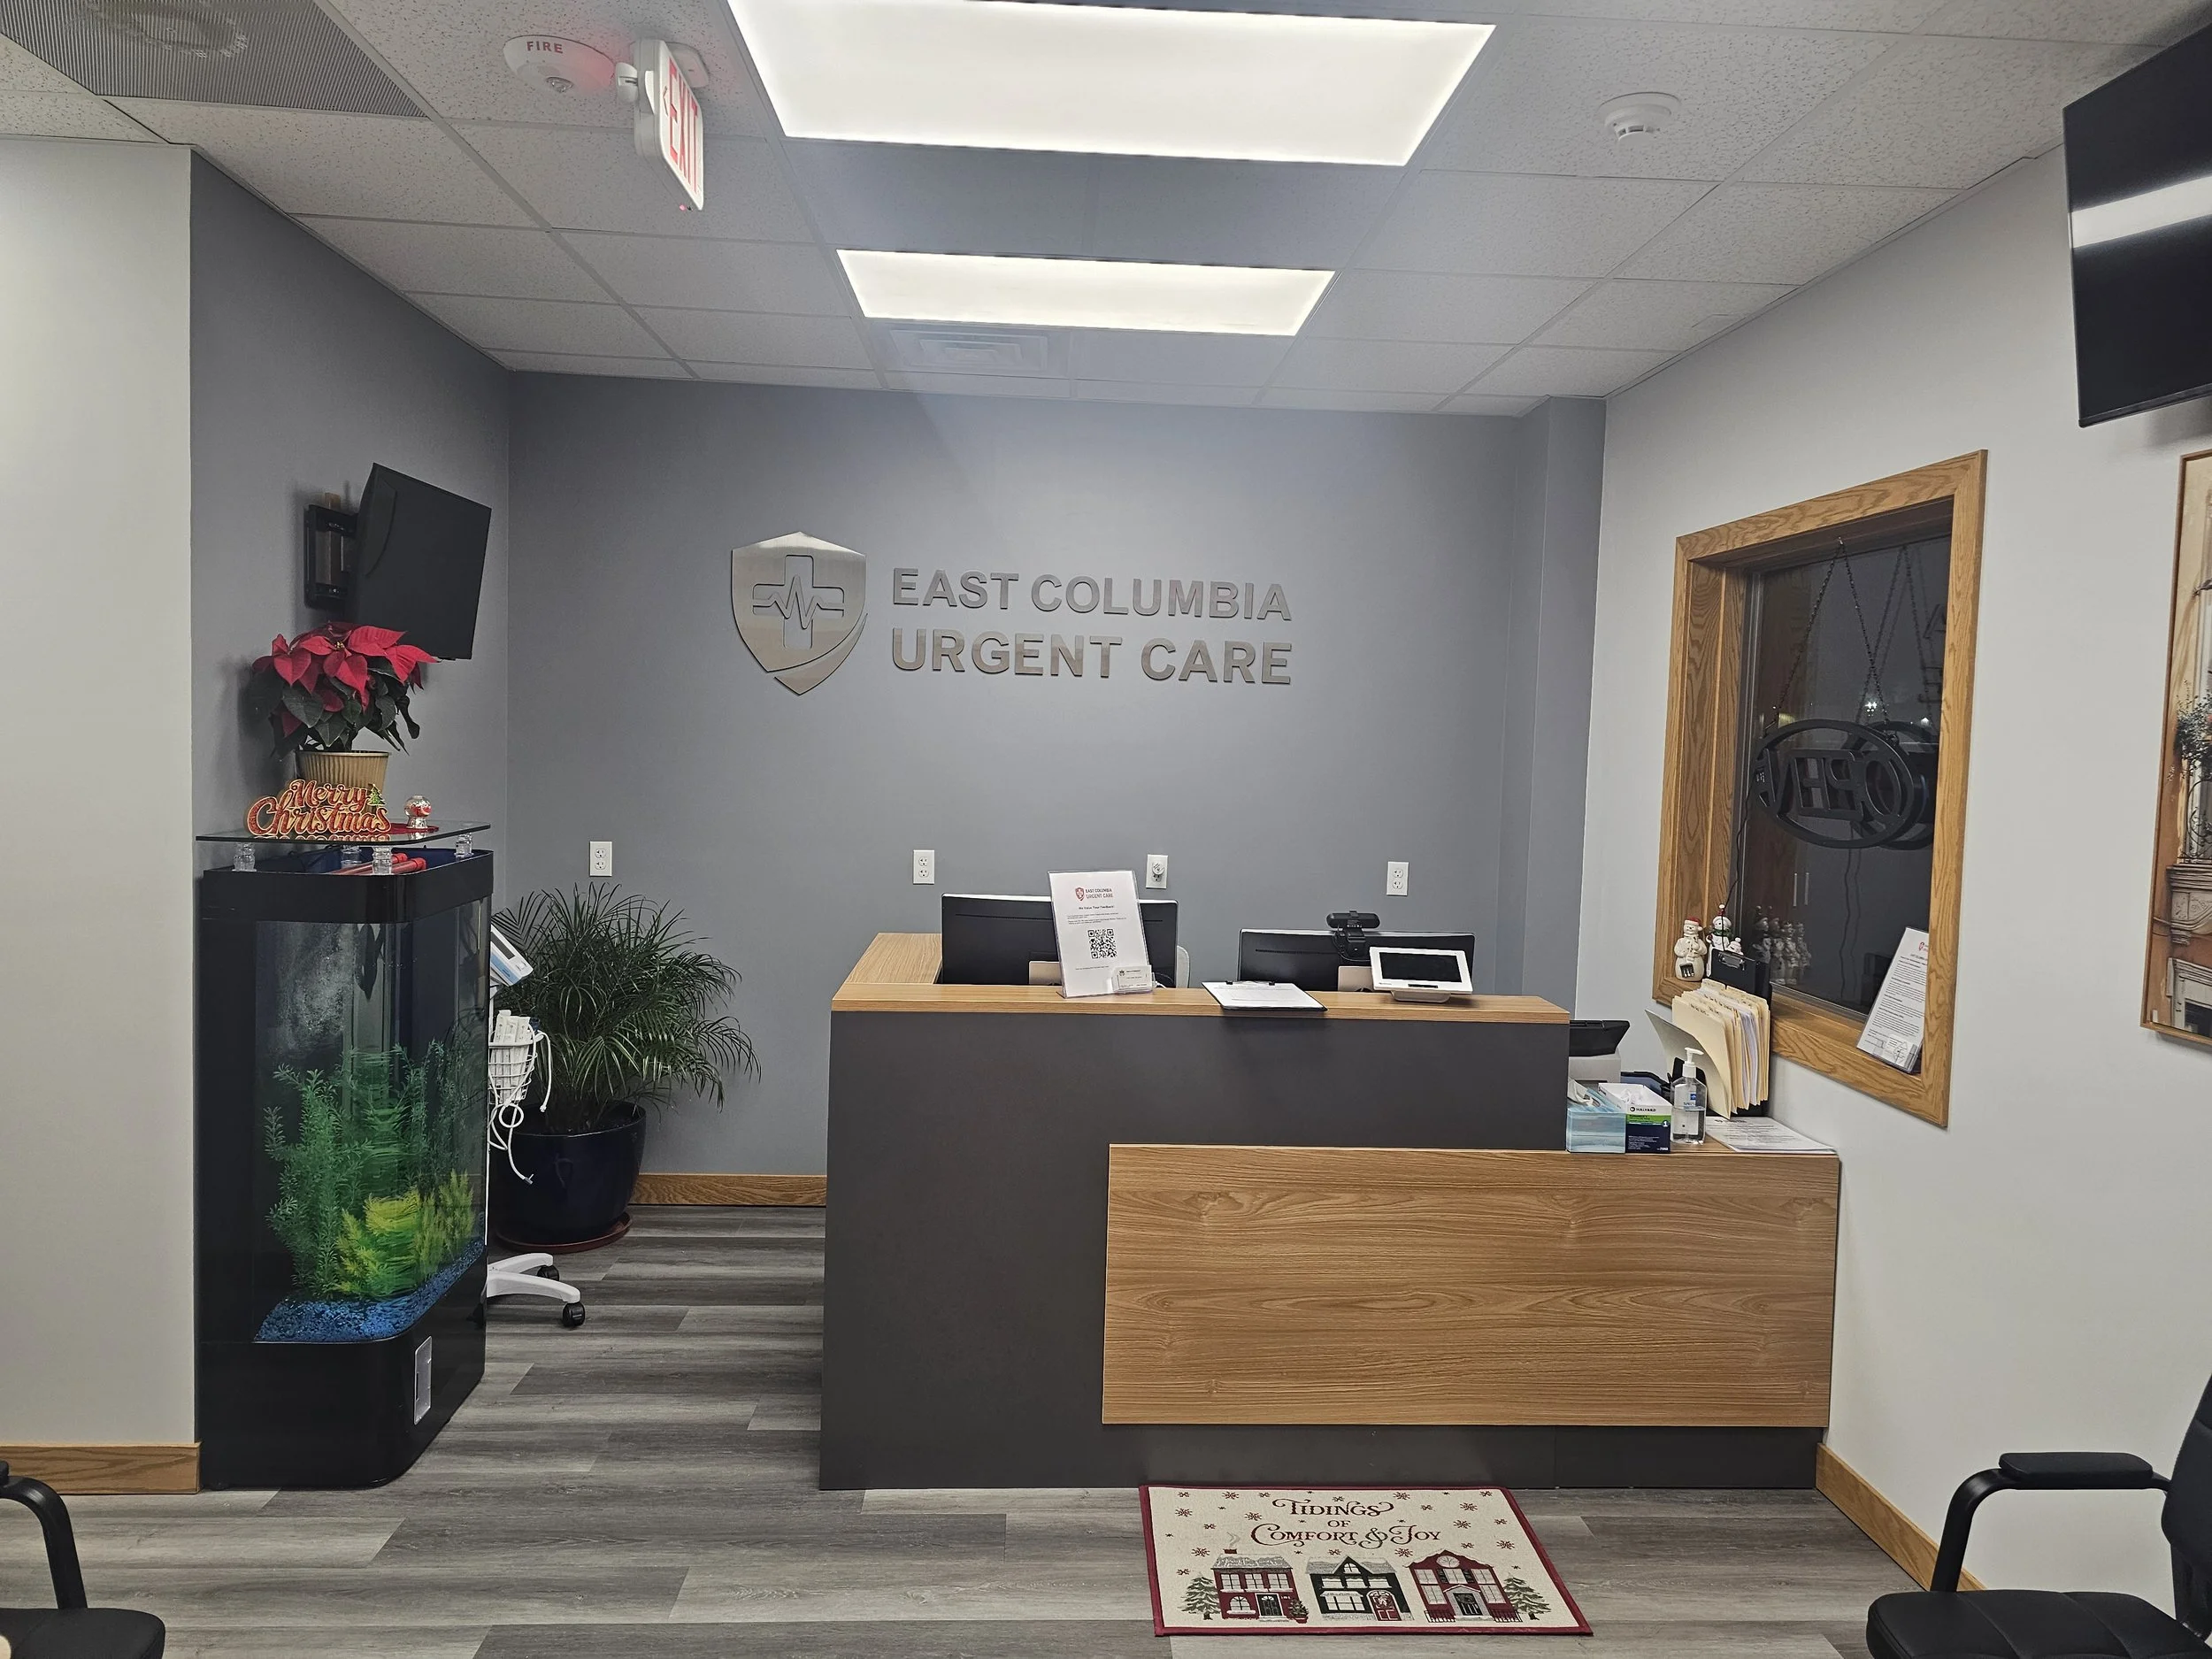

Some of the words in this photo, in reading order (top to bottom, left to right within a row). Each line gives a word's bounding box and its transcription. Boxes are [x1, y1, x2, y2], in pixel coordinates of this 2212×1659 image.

[526, 41, 564, 54] FIRE
[669, 57, 698, 195] EXIT
[893, 567, 1019, 610] EAST
[1030, 574, 1292, 621] COLUMBIA
[892, 627, 1123, 677] URGENT
[1141, 637, 1293, 685] CARE
[247, 790, 391, 835] Christmas
[287, 779, 370, 814] Merry
[1272, 1498, 1394, 1517] TIDINGS
[1250, 1523, 1358, 1547] COMFORT
[1358, 1528, 1388, 1549] &
[1389, 1525, 1441, 1545] JOY
